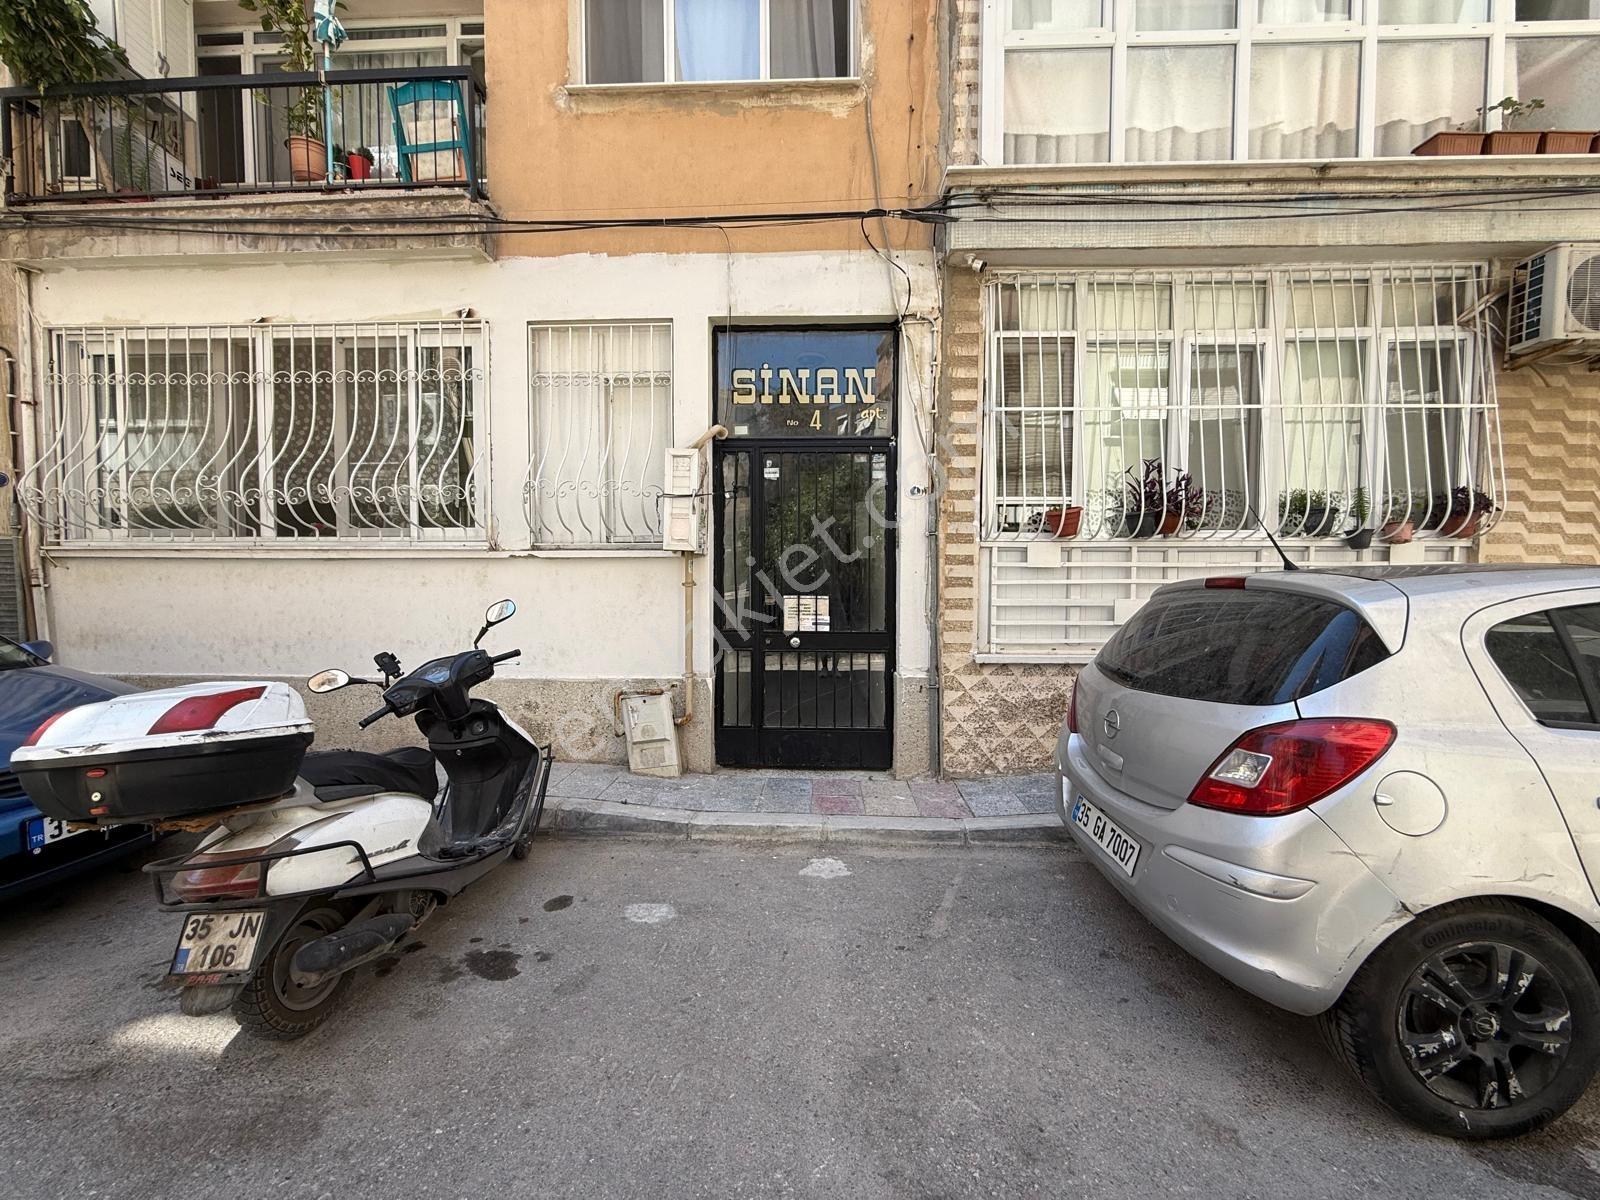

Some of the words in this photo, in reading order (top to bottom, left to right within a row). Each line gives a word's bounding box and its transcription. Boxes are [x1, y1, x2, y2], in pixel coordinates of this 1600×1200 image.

[809, 409, 822, 431] 4
[31, 833, 44, 843] TR
[1077, 803, 1091, 827] 35
[1093, 815, 1107, 843] GA
[1106, 827, 1136, 866] 7007
[185, 917, 214, 940] 35
[229, 915, 261, 938] JN
[199, 944, 237, 968] 106
